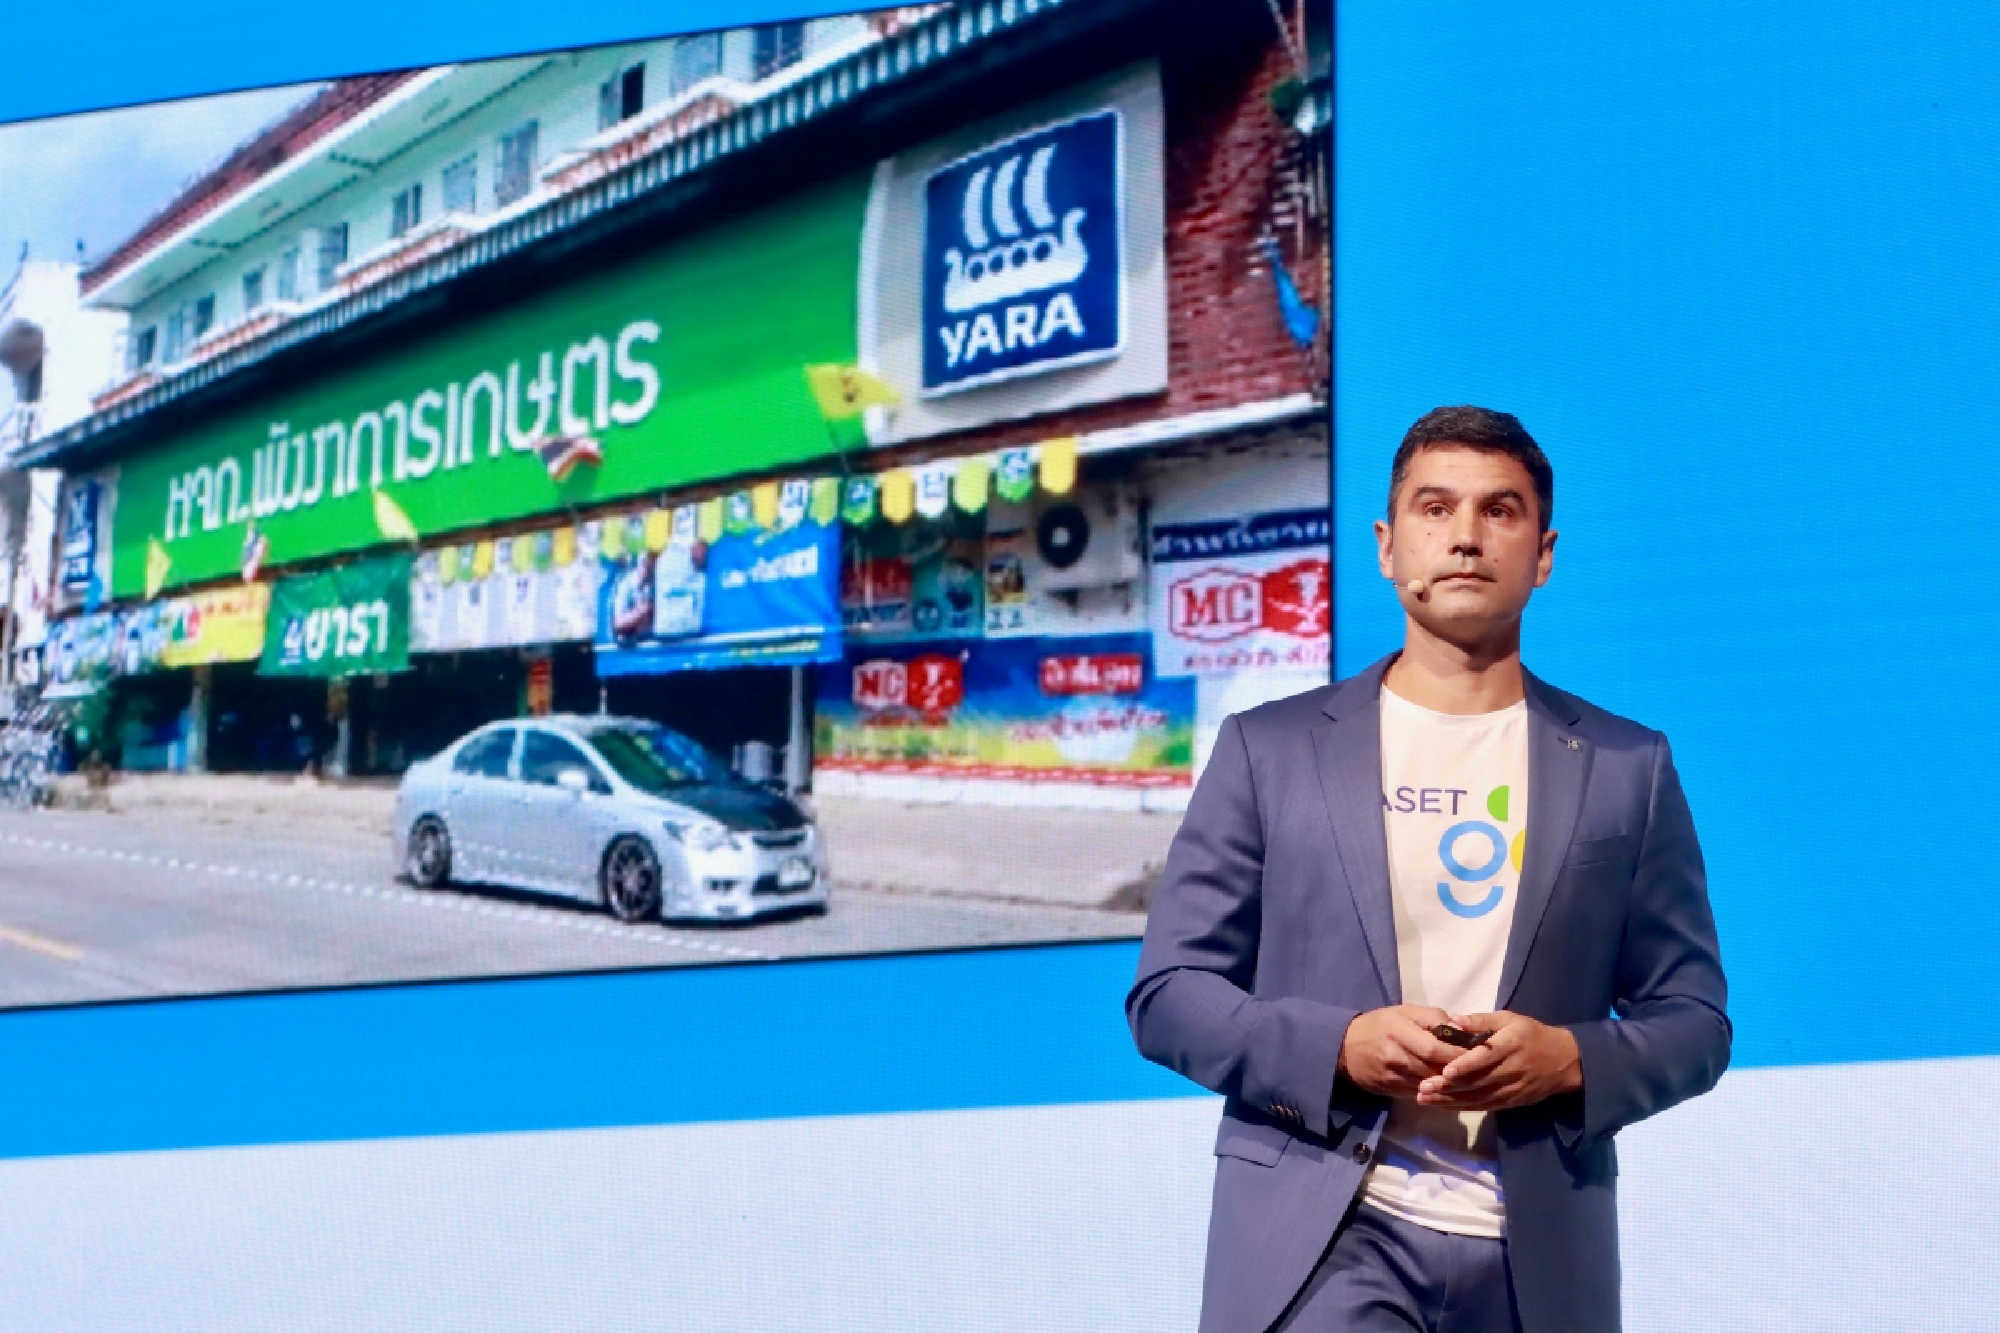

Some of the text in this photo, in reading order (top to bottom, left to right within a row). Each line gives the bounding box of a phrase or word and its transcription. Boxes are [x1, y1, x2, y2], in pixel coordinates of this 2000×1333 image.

[939, 292, 1087, 370] YARA
[164, 319, 661, 540] หจก.พังงาการเกษตร
[304, 597, 390, 663] ยารา
[1181, 582, 1255, 628] MC
